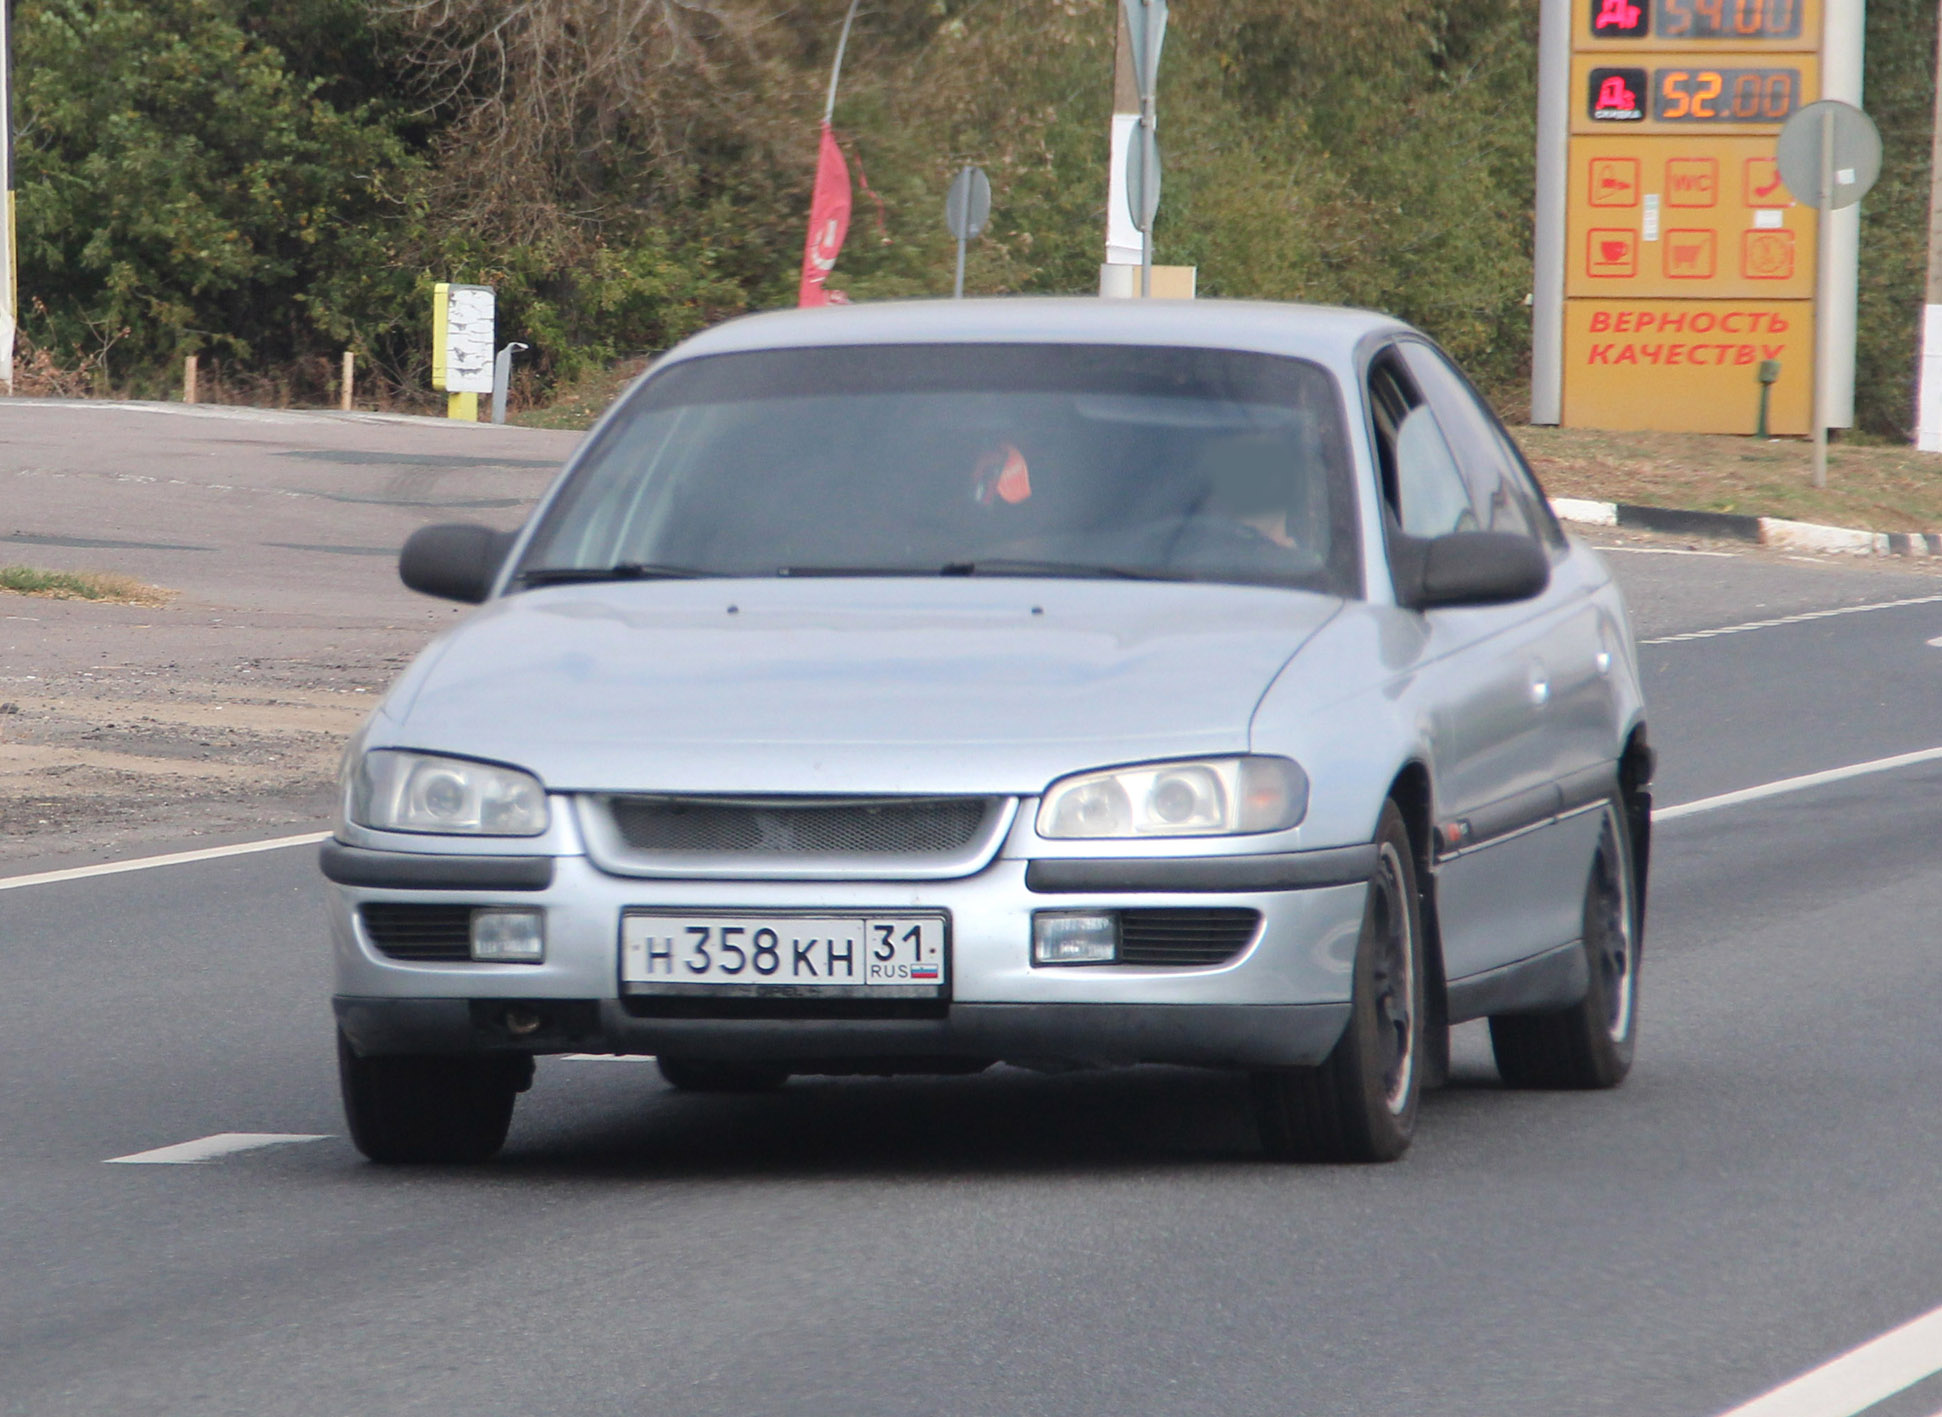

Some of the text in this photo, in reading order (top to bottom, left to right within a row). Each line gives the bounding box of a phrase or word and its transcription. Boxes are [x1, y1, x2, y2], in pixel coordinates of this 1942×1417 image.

[1662, 72, 1791, 118] 52.00
[1672, 174, 1712, 192] WC
[1588, 311, 1790, 334] ВЕРНОСТЬ
[1587, 343, 1786, 366] КАЧЕСТВУ
[873, 925, 921, 962] 31
[871, 964, 908, 978] RUS
